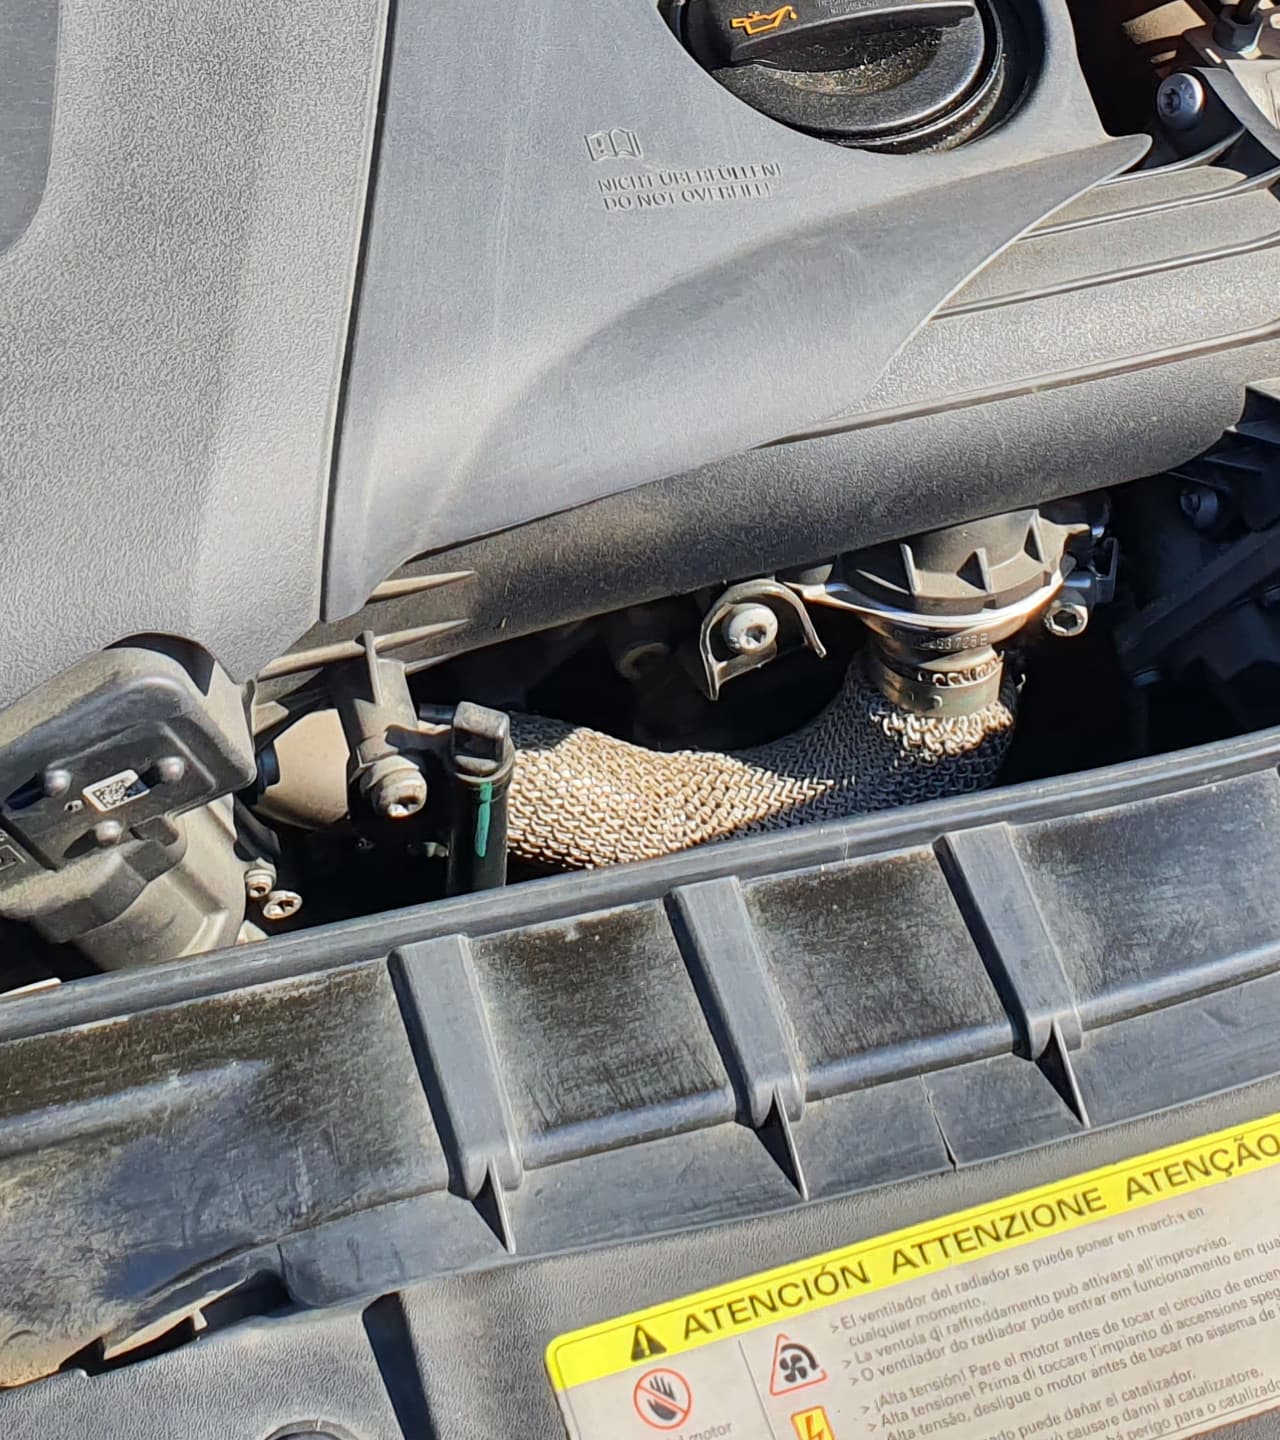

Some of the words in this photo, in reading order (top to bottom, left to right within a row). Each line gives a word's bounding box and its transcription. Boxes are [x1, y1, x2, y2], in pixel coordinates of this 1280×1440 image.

[603, 196, 632, 212] DO
[637, 191, 675, 209] NOT
[683, 1260, 870, 1340] ATENCIÓN
[891, 1187, 1107, 1275] ATTENZIONE
[1126, 1133, 1280, 1202] ATENÇÃO
[1101, 1319, 1120, 1335] de
[1120, 1309, 1154, 1328] tocar
[1223, 1280, 1241, 1295] de
[1033, 1386, 1044, 1397] o
[1129, 1350, 1147, 1366] de
[1258, 1307, 1276, 1322] de
[1206, 1402, 1216, 1414] o
